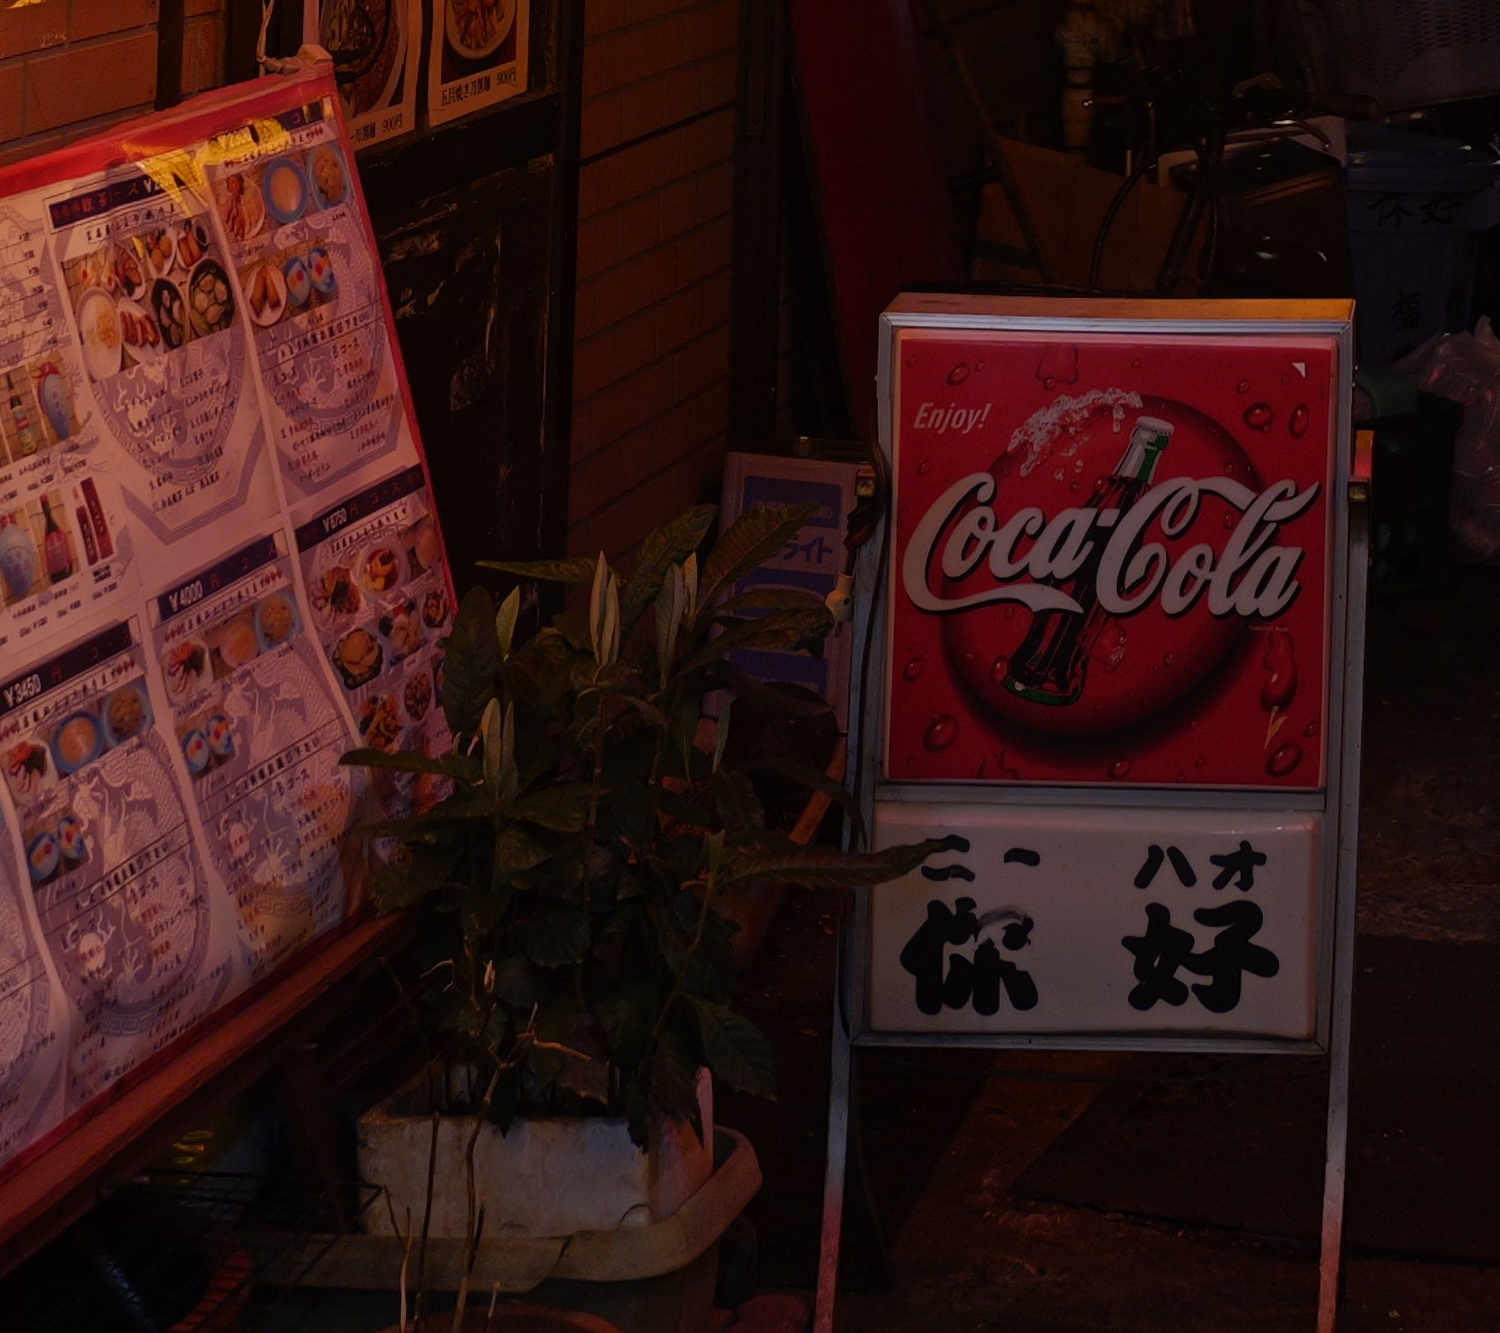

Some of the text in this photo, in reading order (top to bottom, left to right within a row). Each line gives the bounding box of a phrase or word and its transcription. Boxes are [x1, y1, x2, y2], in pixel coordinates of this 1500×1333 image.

[911, 400, 992, 435] Enjoy!
[772, 532, 834, 565] ライト
[901, 471, 1320, 619] Coca-Cola
[1133, 840, 1267, 894] ハオ
[899, 895, 1281, 1016] 你好
